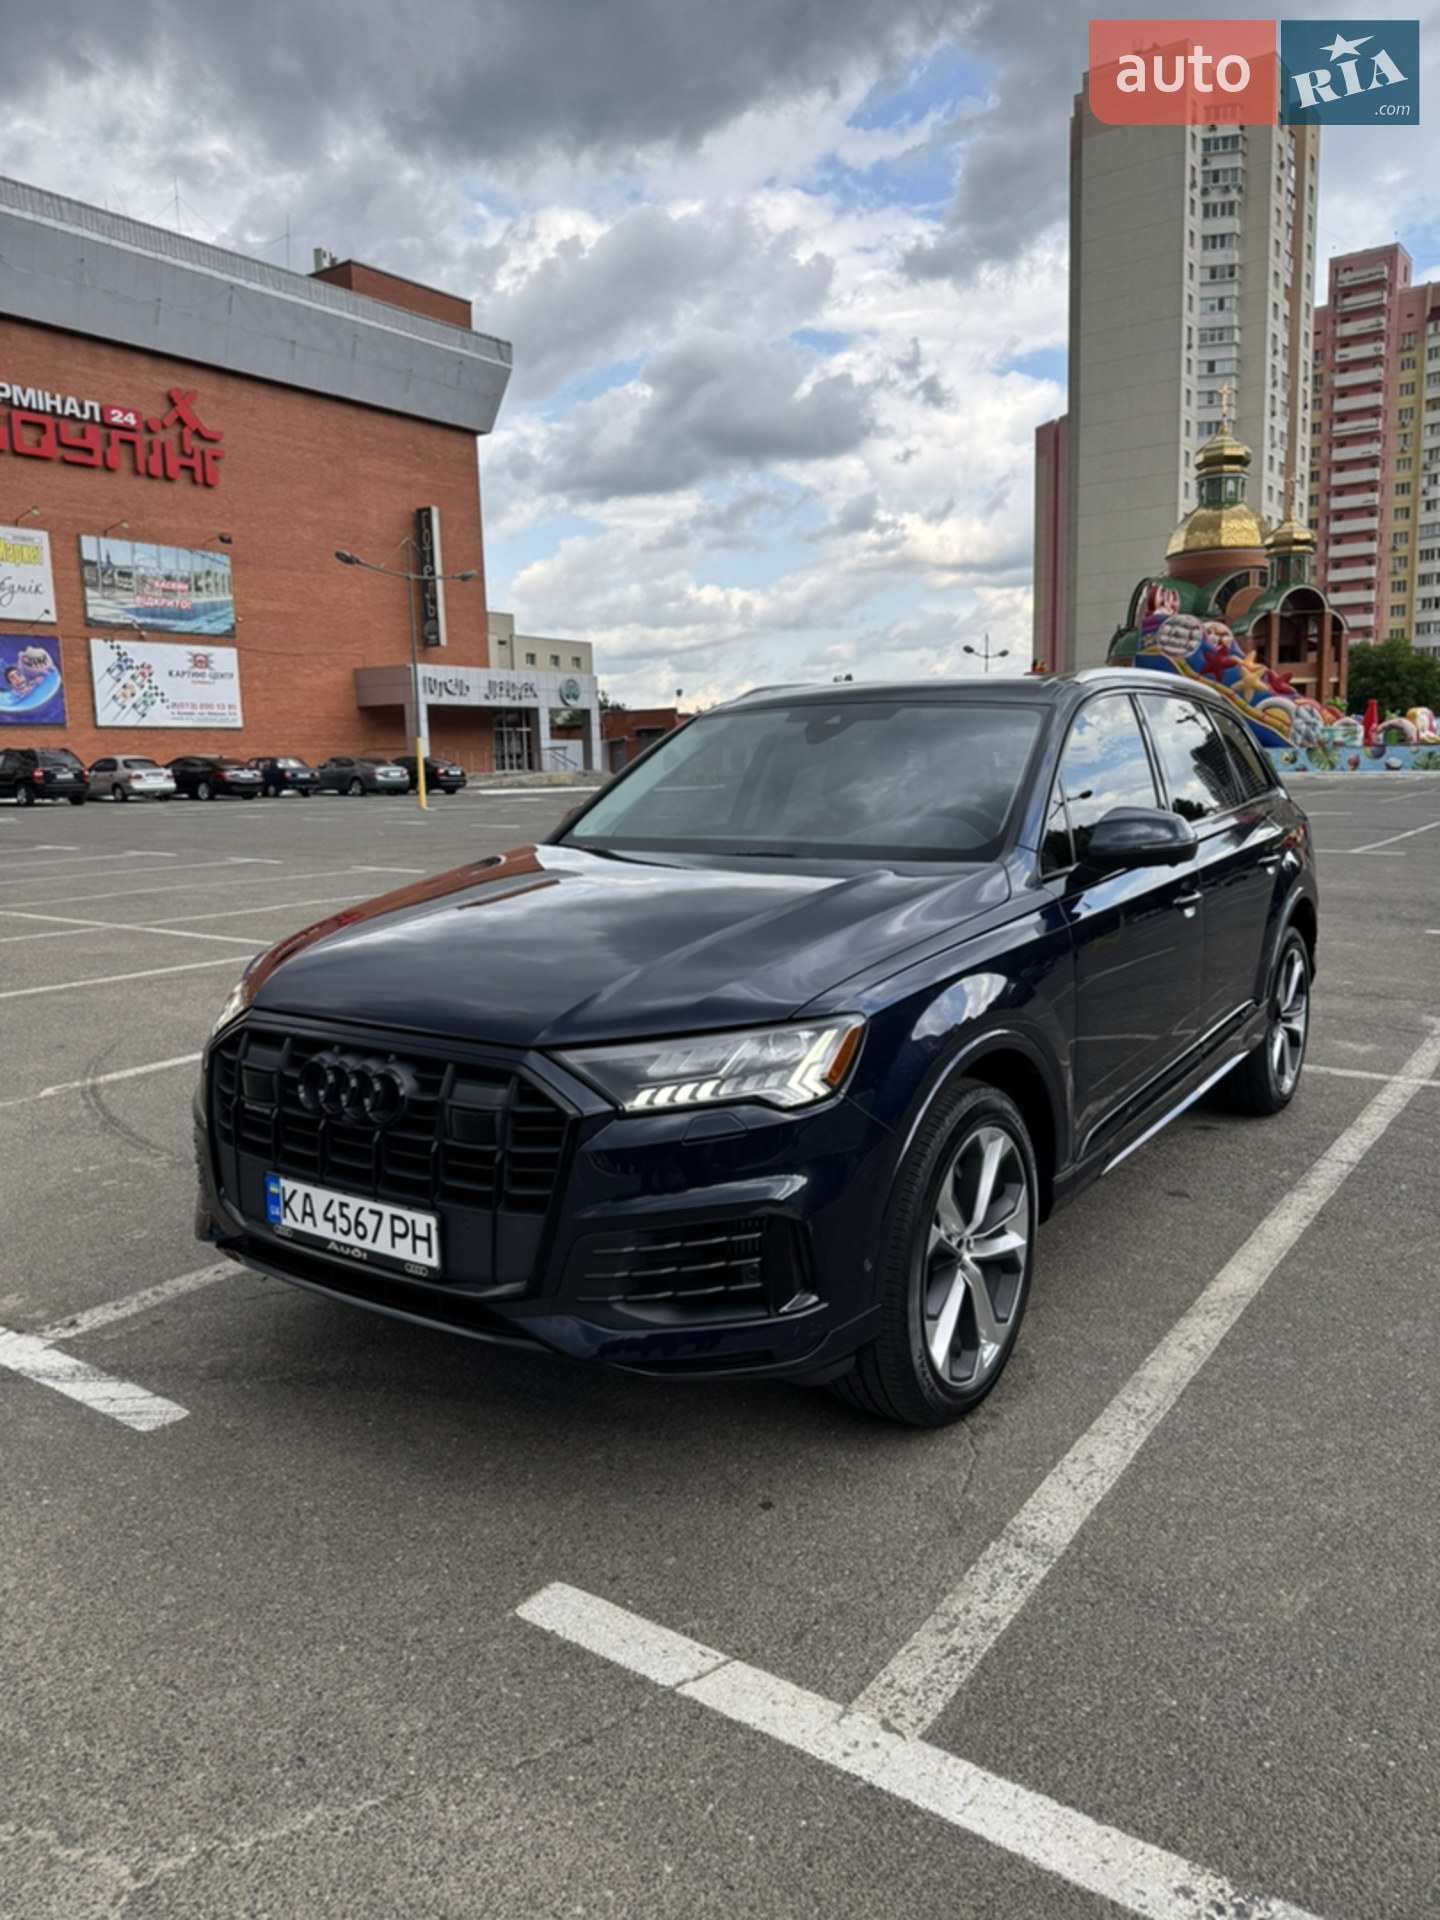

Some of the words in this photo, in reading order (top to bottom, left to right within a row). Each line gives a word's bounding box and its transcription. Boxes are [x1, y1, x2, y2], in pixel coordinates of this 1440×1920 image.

[0, 410, 225, 488] ОУЛІНГ
[110, 409, 137, 426] 24
[281, 1186, 317, 1229] KA
[322, 1199, 383, 1244] 4567
[390, 1213, 433, 1259] PH
